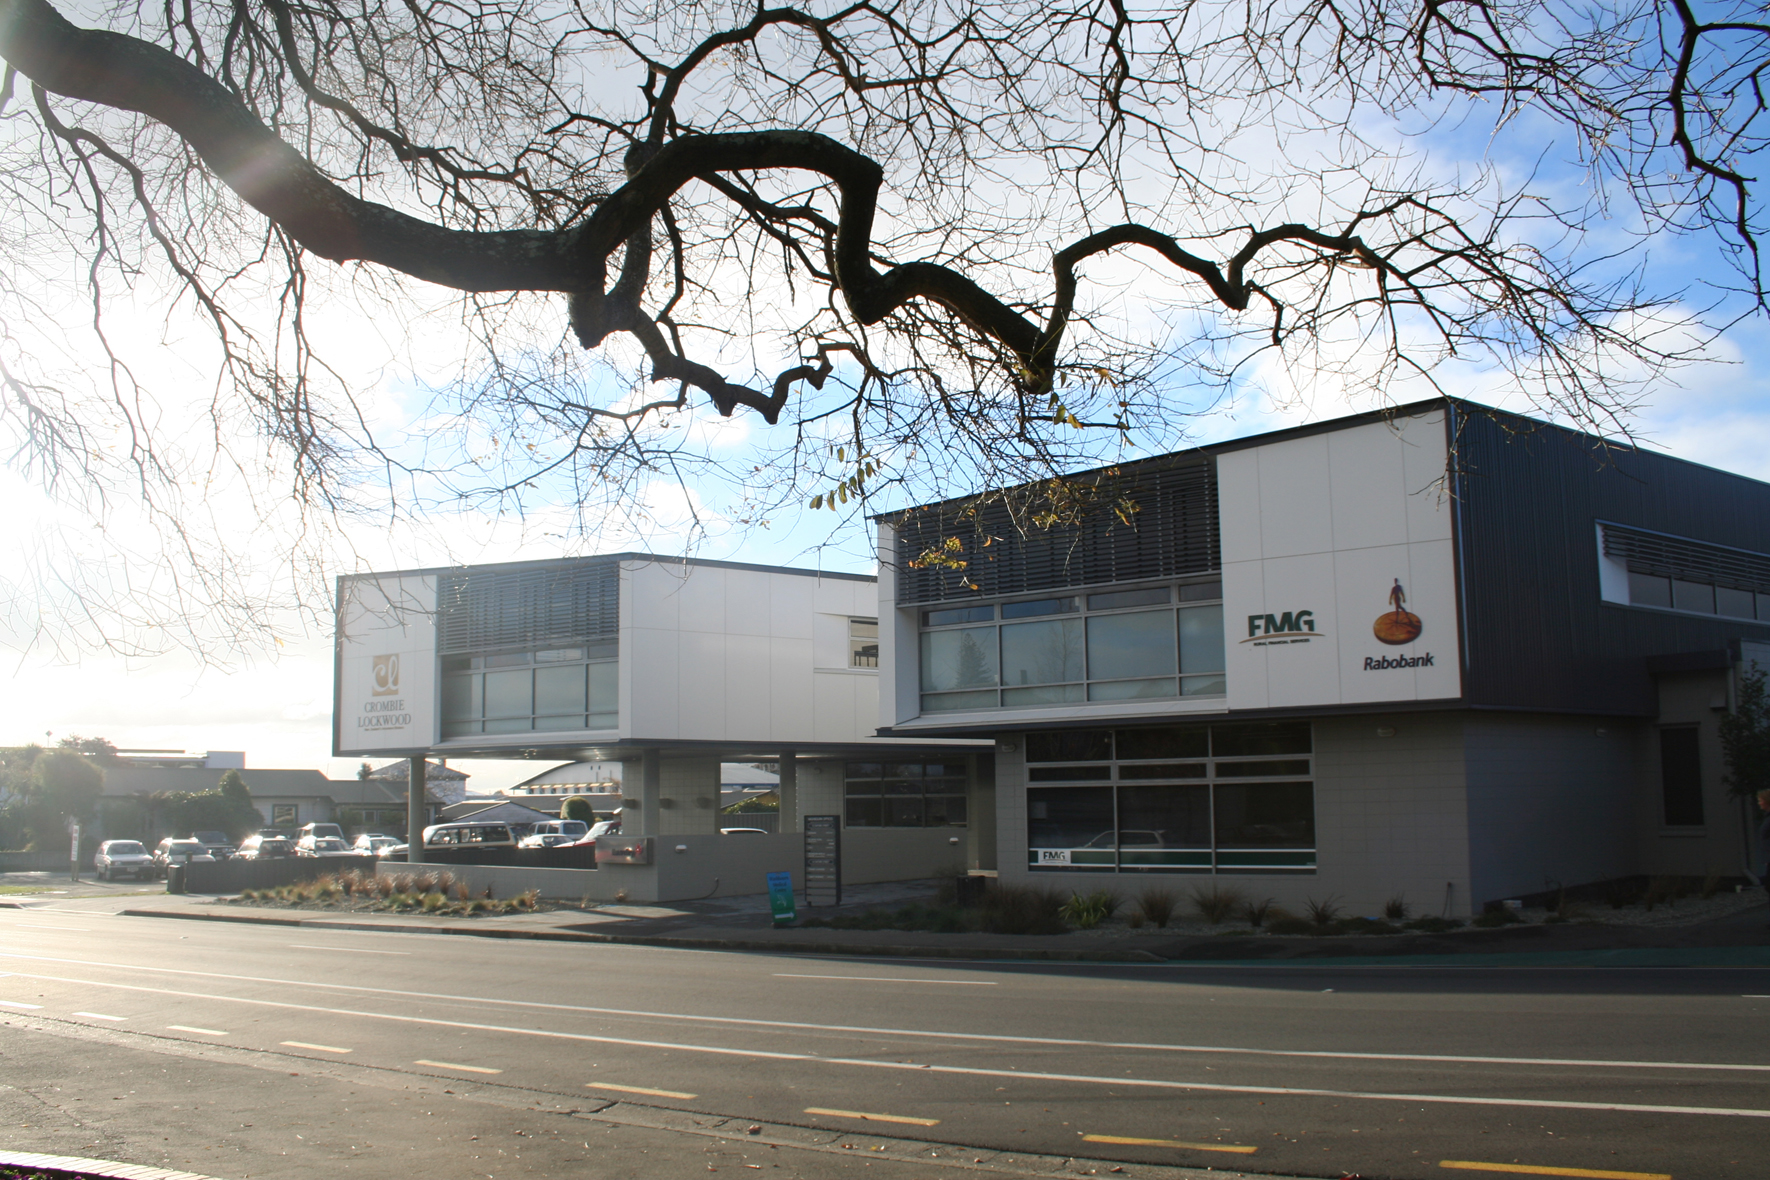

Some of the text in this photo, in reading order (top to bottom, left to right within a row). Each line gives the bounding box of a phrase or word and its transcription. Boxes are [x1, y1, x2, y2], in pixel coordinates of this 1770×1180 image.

[1248, 610, 1315, 637] FMG
[1364, 652, 1434, 671] Rabobank
[364, 699, 405, 713] CROMBIE
[358, 713, 411, 727] LOCKWOOD
[1043, 851, 1066, 859] FMG
